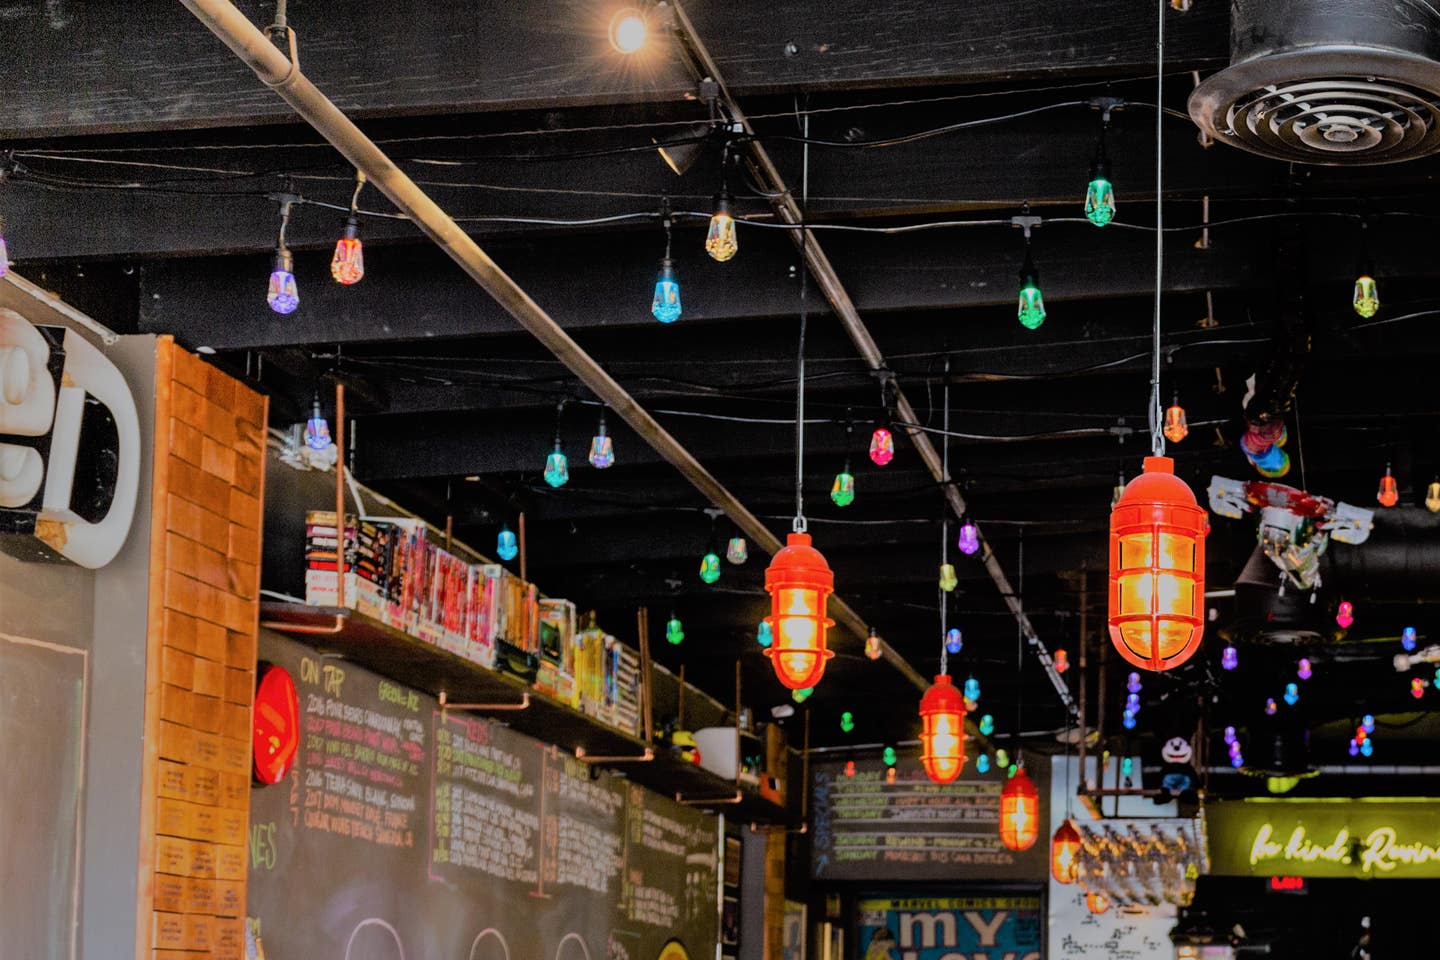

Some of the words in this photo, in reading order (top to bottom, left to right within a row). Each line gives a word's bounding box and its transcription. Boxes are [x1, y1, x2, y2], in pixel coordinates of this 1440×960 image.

[300, 656, 320, 686] ON
[322, 664, 346, 699] TAP
[835, 849, 878, 862] SUNDAY
[890, 899, 939, 908] MARVEL
[948, 899, 997, 908] COMICS
